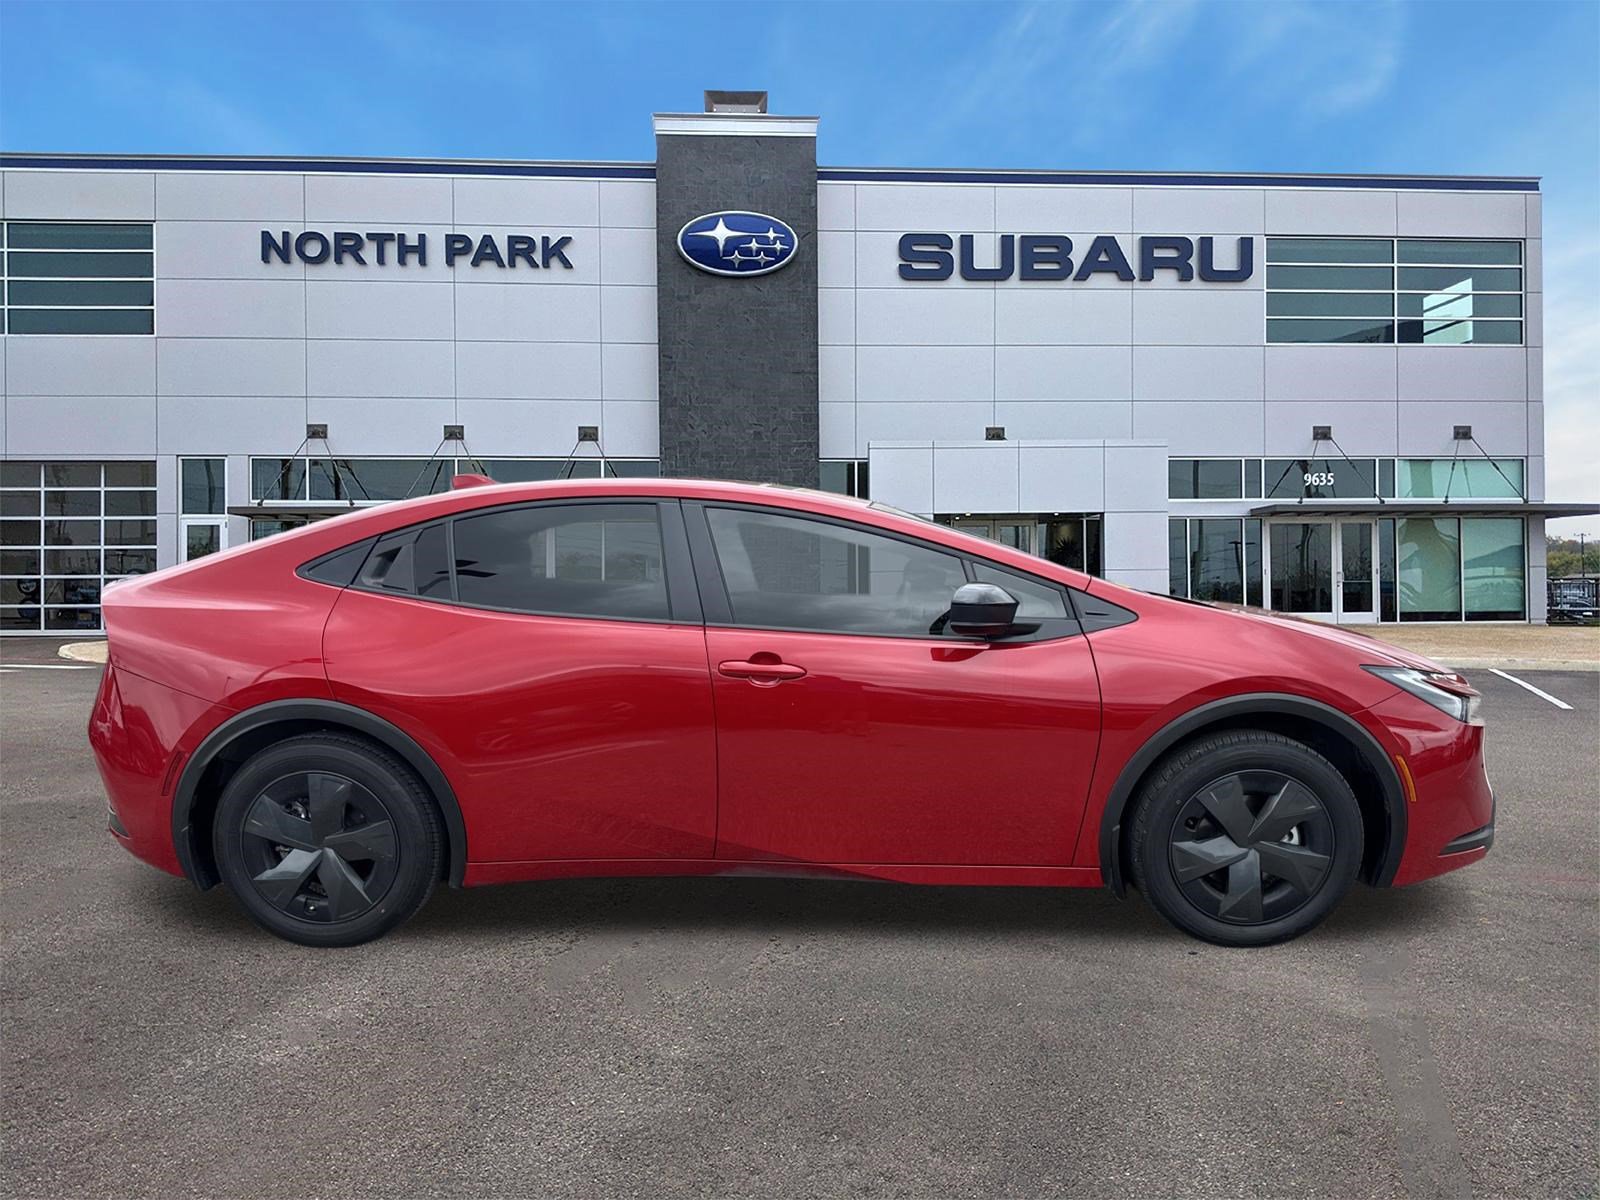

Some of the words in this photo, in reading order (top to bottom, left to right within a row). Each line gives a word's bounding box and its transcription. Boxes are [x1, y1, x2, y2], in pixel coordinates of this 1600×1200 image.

[261, 231, 427, 267] NORTH
[445, 234, 574, 269] PARK
[898, 233, 1254, 283] SUBARU
[1303, 473, 1335, 486] 9635
